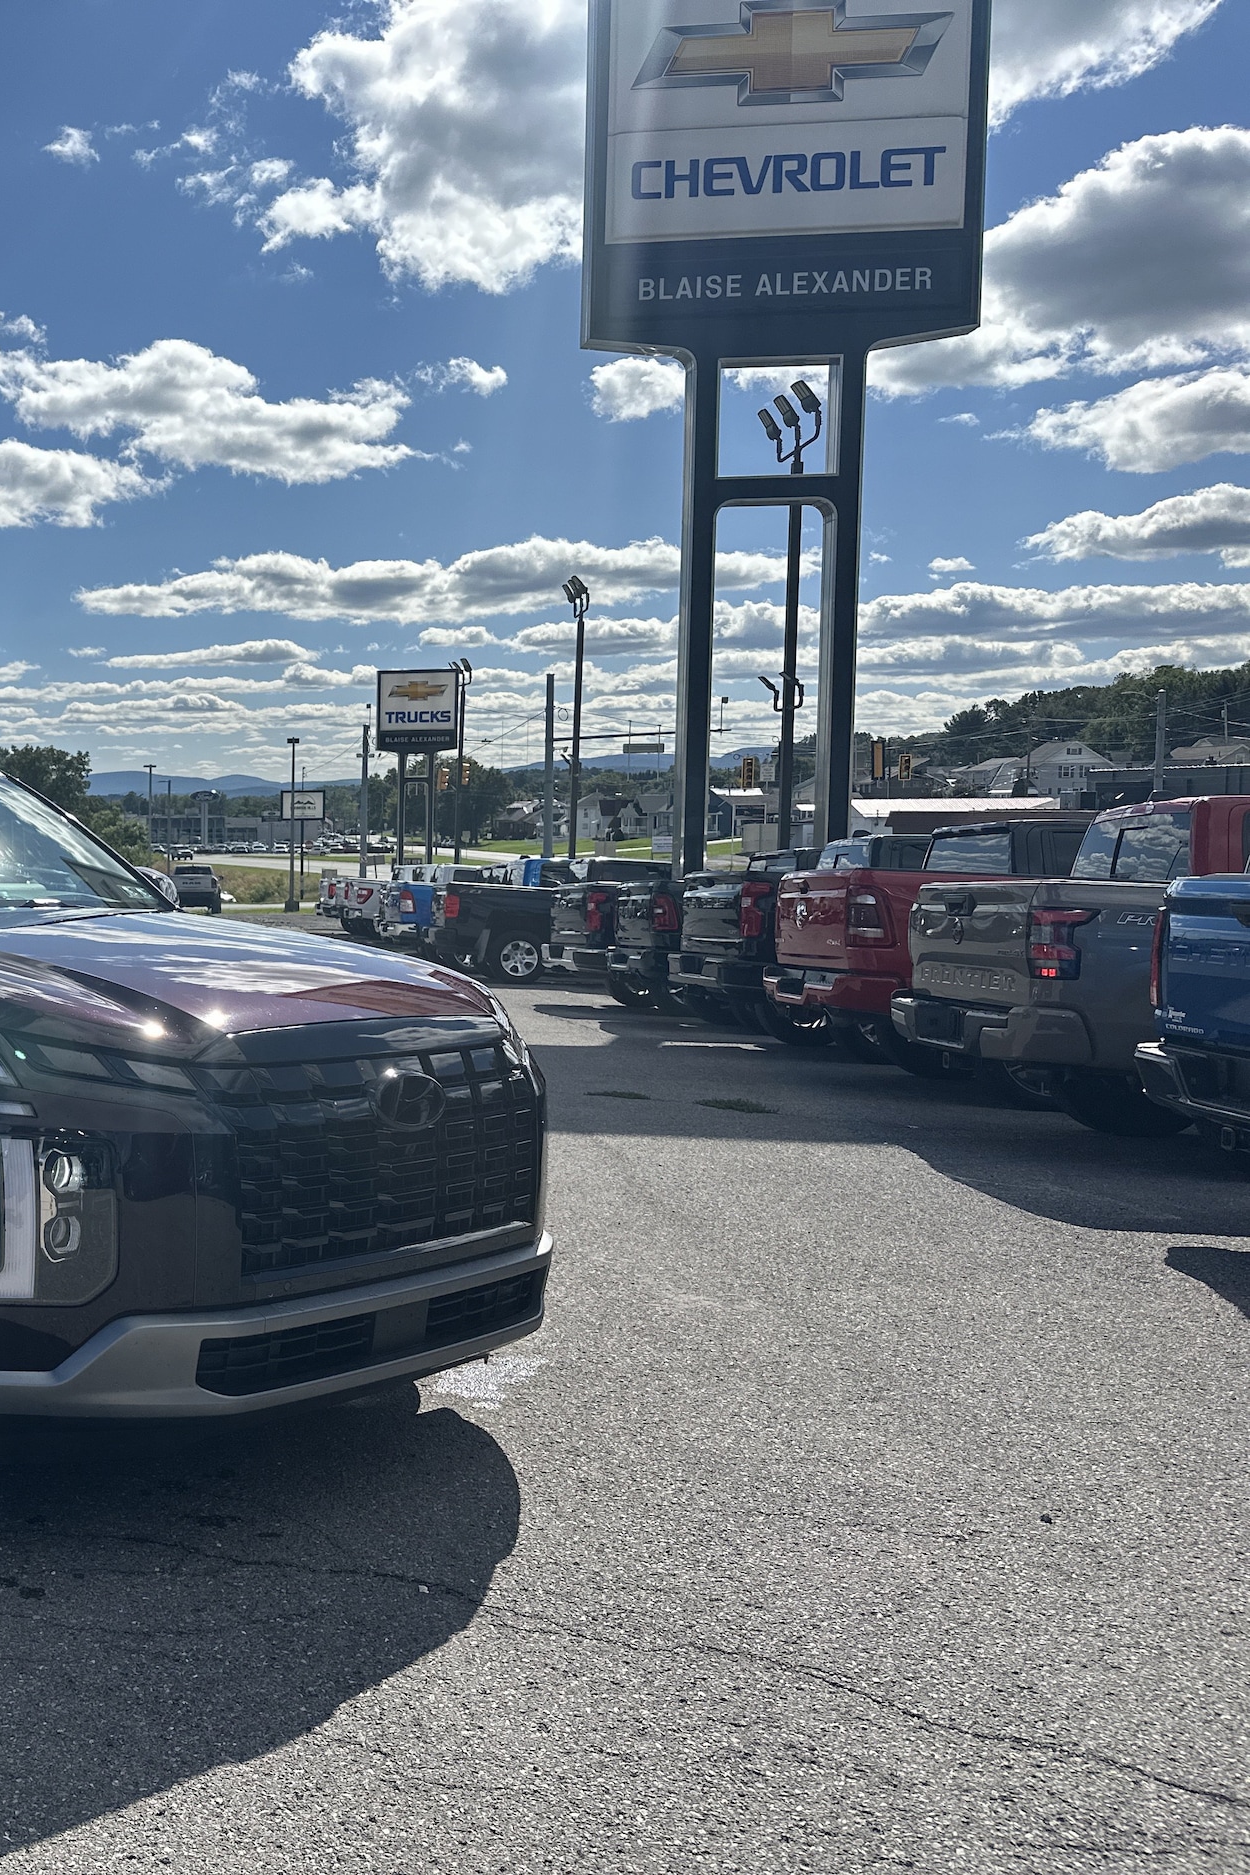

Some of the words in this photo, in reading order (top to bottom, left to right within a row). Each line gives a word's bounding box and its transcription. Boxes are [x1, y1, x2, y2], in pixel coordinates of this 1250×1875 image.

[630, 146, 947, 200] CHEVROLET
[638, 274, 743, 301] BLAISE
[754, 267, 933, 296] ALEXANDER
[385, 710, 452, 724] TRUCKS
[410, 735, 450, 743] ALEXANDER
[921, 966, 1017, 992] FRONTIER
[1165, 1023, 1205, 1035] COLORADO
